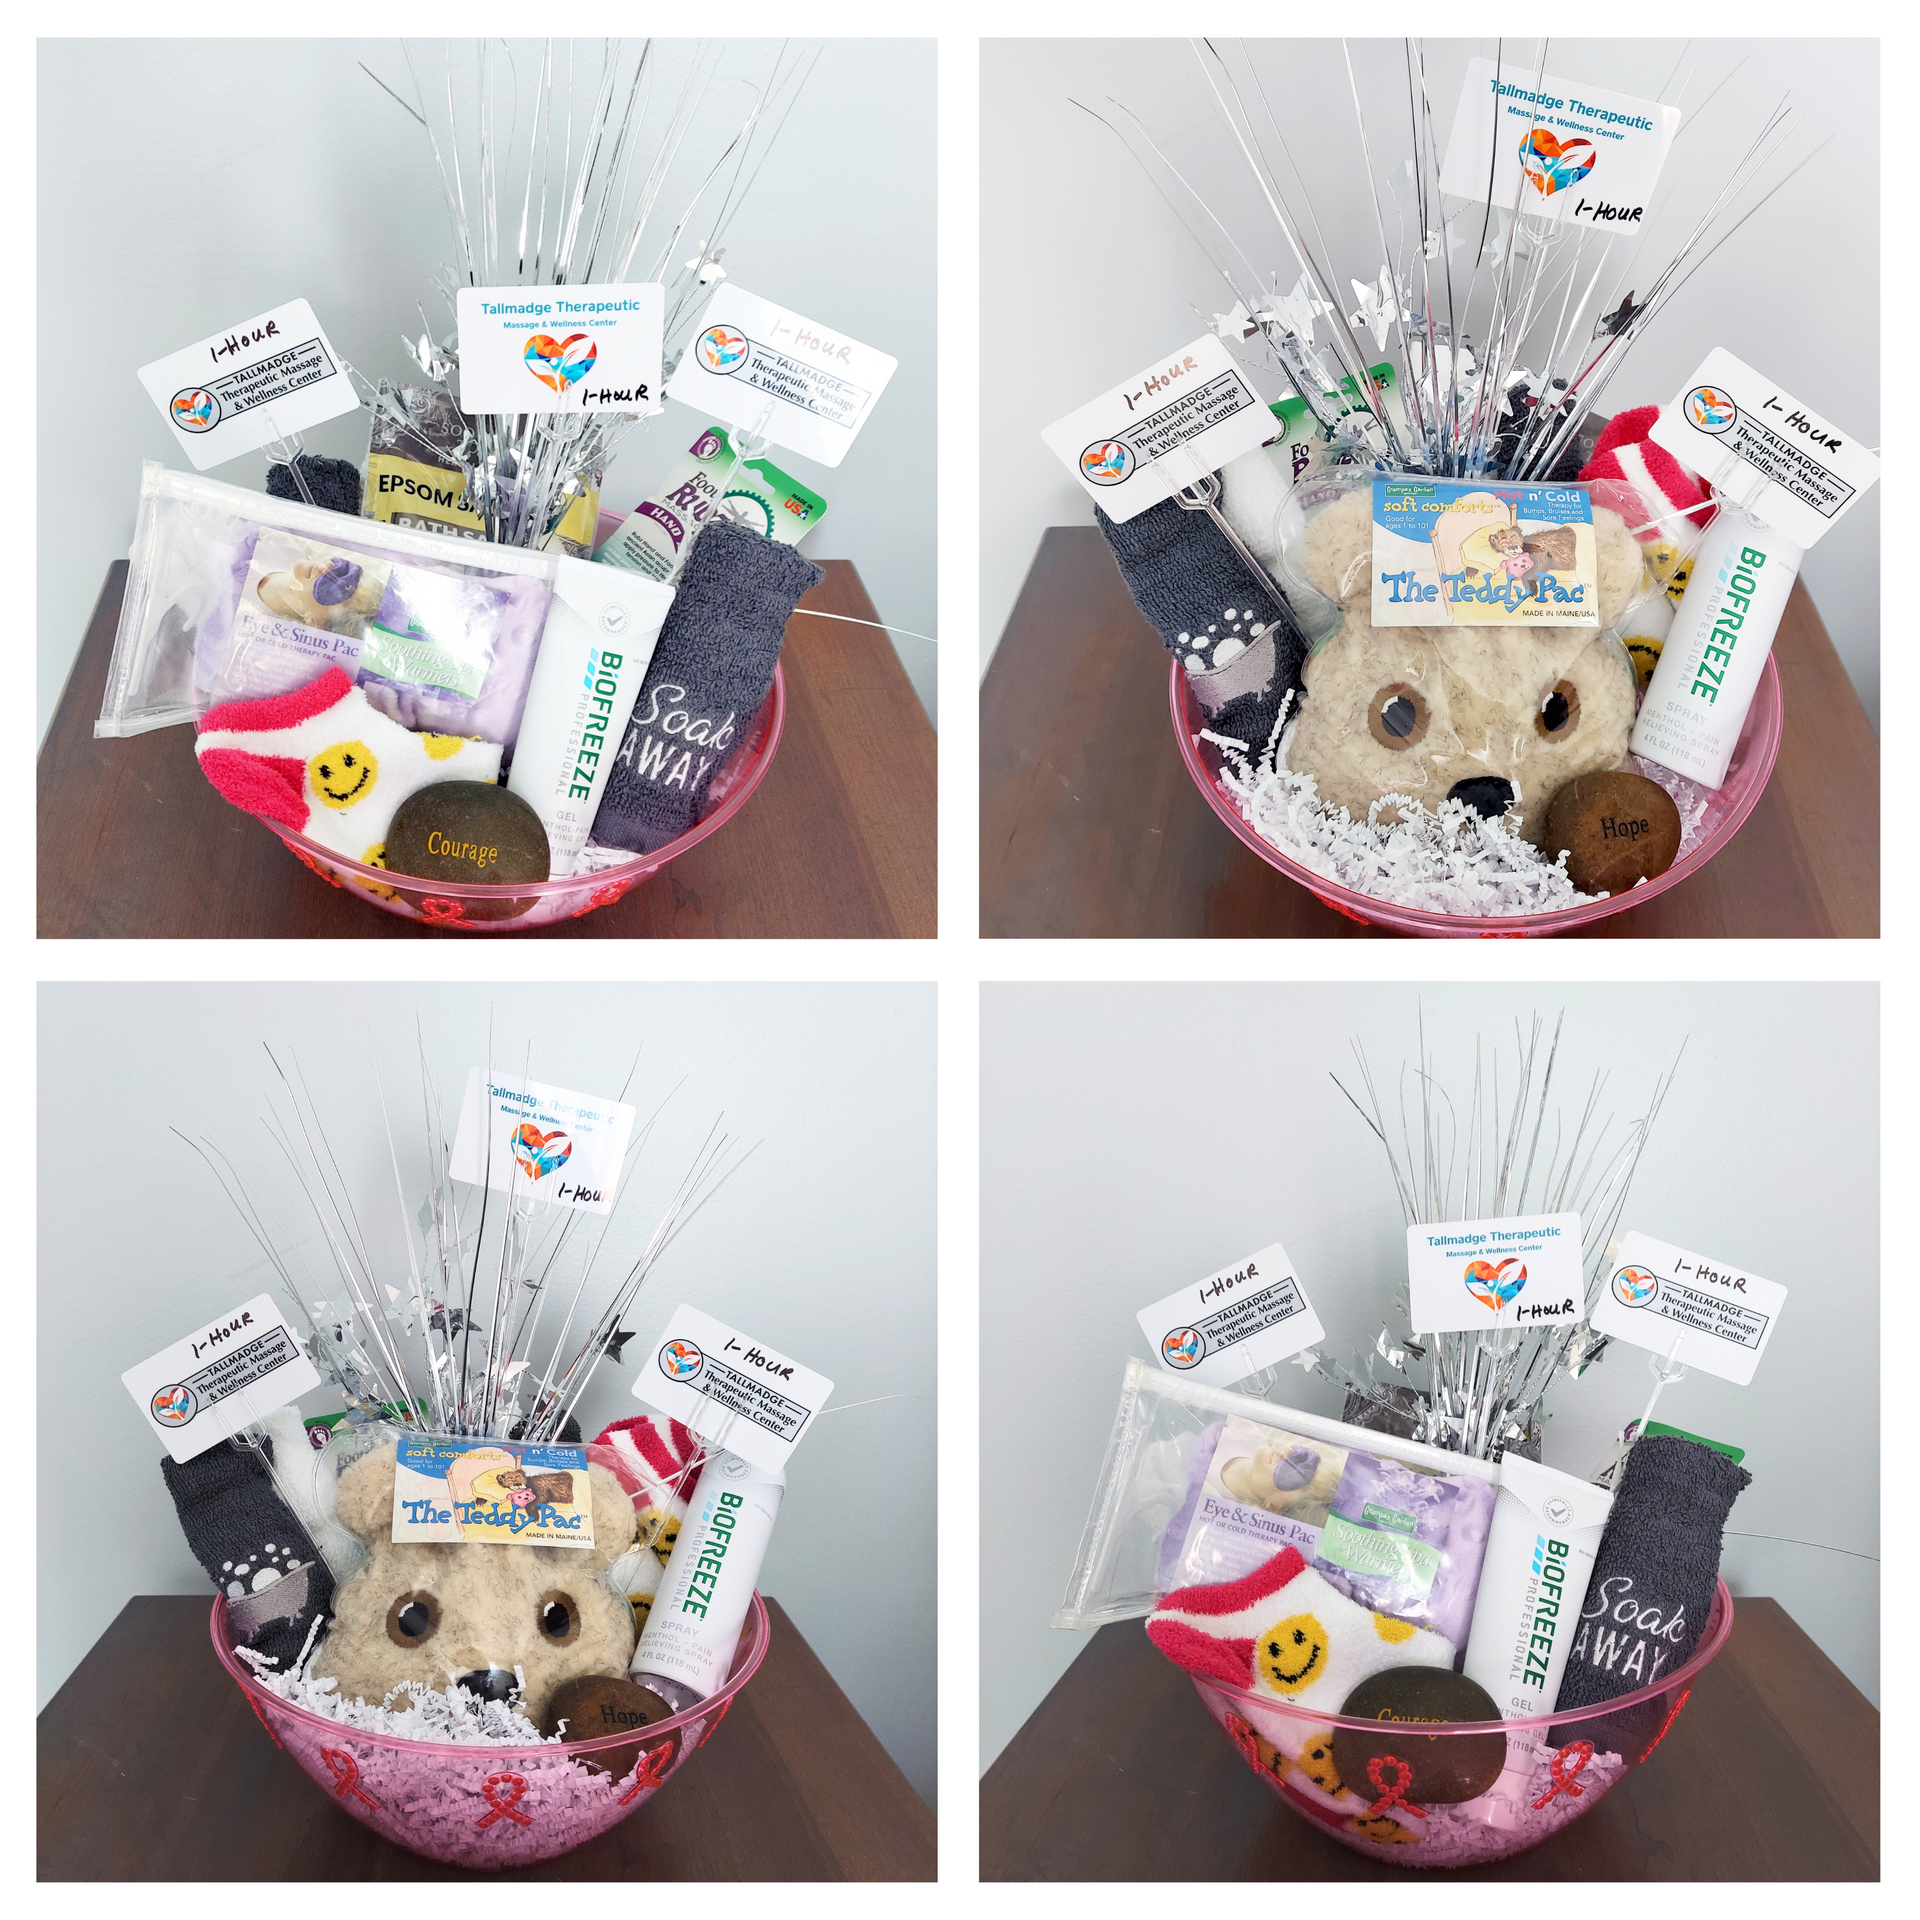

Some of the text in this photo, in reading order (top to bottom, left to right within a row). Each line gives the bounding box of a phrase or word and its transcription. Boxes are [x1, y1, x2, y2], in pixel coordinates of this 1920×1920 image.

[1491, 80, 1653, 131] Tallmadge Therapeutic
[1507, 106, 1625, 141] Massage & Wellness Center
[481, 299, 640, 315] Tallmadge Therapeutic
[504, 321, 539, 329] Massage
[220, 354, 323, 402] Therapeutic Massage
[233, 351, 298, 385] TALLMADGE
[751, 358, 856, 412] Therapeutic Massage
[776, 357, 843, 392] TALLMADGE
[234, 370, 322, 411] & Wellness Center
[750, 374, 843, 420] & Wellness Center
[1145, 387, 1213, 430] TALLMADGE
[1132, 385, 1239, 450] Therapeutic Massage
[1149, 399, 1241, 457] & Wellness Center
[1733, 440, 1743, 450] &
[1788, 478, 1824, 508] Center
[1736, 426, 1838, 503] Therapeutic Massage
[1761, 431, 1828, 481] TALLMADGE
[378, 474, 453, 509] EPSOM
[784, 498, 809, 520] USA
[1383, 497, 1493, 514] soft comforts
[1494, 489, 1524, 500] Hot
[1545, 491, 1581, 502] Cold
[650, 507, 681, 536] HAND
[1382, 571, 1585, 613] The Teddy Pac
[1556, 610, 1596, 618] MAINE/USA
[1677, 585, 1724, 690] PROFESSIONAL
[631, 684, 736, 750] Soak
[1646, 709, 1720, 746] MENTHOL PAIN
[1666, 701, 1708, 725] SPRAY
[555, 692, 590, 796] PROFESSIONAL
[1642, 718, 1720, 756] RELIEVING SPRAY
[1649, 736, 1657, 745] FL
[1659, 740, 1671, 751] OZ
[1671, 746, 1690, 760] (118
[616, 728, 714, 792] AWAY
[556, 810, 577, 822] GEL
[1600, 817, 1650, 842] Hope
[428, 831, 498, 868] Courage
[487, 1083, 544, 1108] Tallmadge
[500, 1105, 531, 1118] Massage
[1427, 1227, 1561, 1247] Tallmadge Therapeutic
[1446, 1250, 1477, 1258] Massage
[1486, 1246, 1516, 1255] Wellness
[1518, 1244, 1542, 1252] Center
[1205, 1292, 1295, 1339] Therapeutic Massage
[1217, 1290, 1274, 1323] TALLMADGE
[1661, 1292, 1758, 1335] Therapeutic Massage
[1682, 1289, 1743, 1318] TALLMADGE
[1217, 1305, 1294, 1347] & Wellness Center
[1661, 1306, 1748, 1343] & Wellness Center
[196, 1339, 287, 1395] Therapeutic Massage
[207, 1340, 265, 1377] TALLMADGE
[209, 1352, 288, 1401] & Wellness Center
[704, 1369, 797, 1427] Therapeutic Massage
[725, 1370, 785, 1408] TALLMADGE
[703, 1383, 785, 1434] & Wellness Center
[406, 1447, 501, 1461] soft comforts
[402, 1499, 581, 1535] The Teddy Pac
[1199, 1516, 1215, 1524] HOT
[1216, 1520, 1226, 1528] OR
[1227, 1524, 1246, 1534] COLD
[1248, 1530, 1278, 1543] THERAPY
[1202, 1498, 1315, 1544] Eye & Sinus Pac
[1333, 1523, 1400, 1561] Soothing
[670, 1525, 707, 1610] PROFESSIONAL
[1510, 1577, 1539, 1680] PROFESSIONAL
[1582, 1577, 1686, 1643] Soak
[661, 1621, 700, 1637] SPRAY
[1570, 1622, 1668, 1685] AWAY
[599, 1704, 648, 1729] Hope
[1511, 1696, 1533, 1712] GEL
